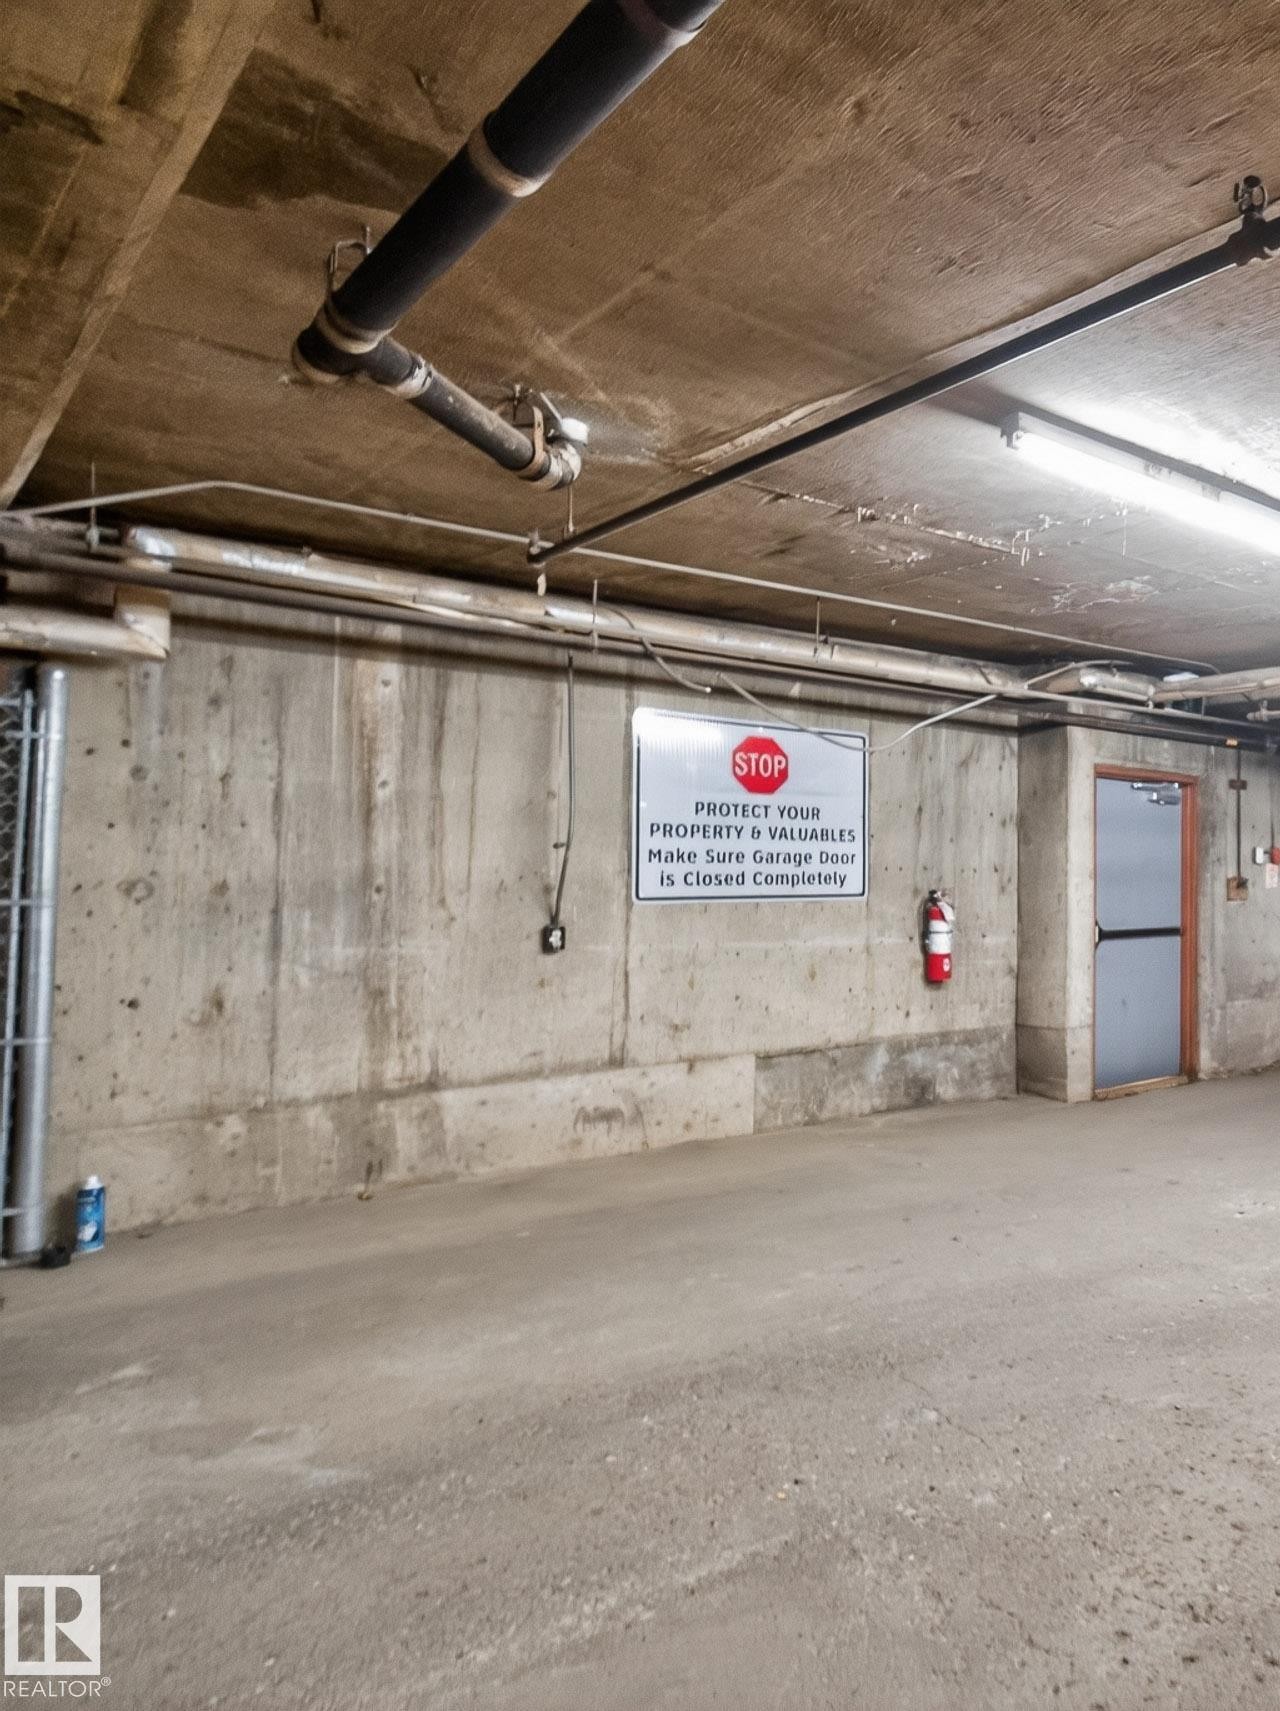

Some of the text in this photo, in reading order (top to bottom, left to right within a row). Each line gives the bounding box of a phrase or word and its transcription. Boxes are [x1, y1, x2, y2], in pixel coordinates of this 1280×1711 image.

[734, 752, 786, 777] STOP
[694, 801, 821, 821] PROTECT YOUR
[649, 822, 856, 843] PROPERTY & VALUABLES
[648, 848, 856, 867] Make Sure Garage Door
[684, 871, 745, 887] Closed
[753, 872, 847, 888] Completely
